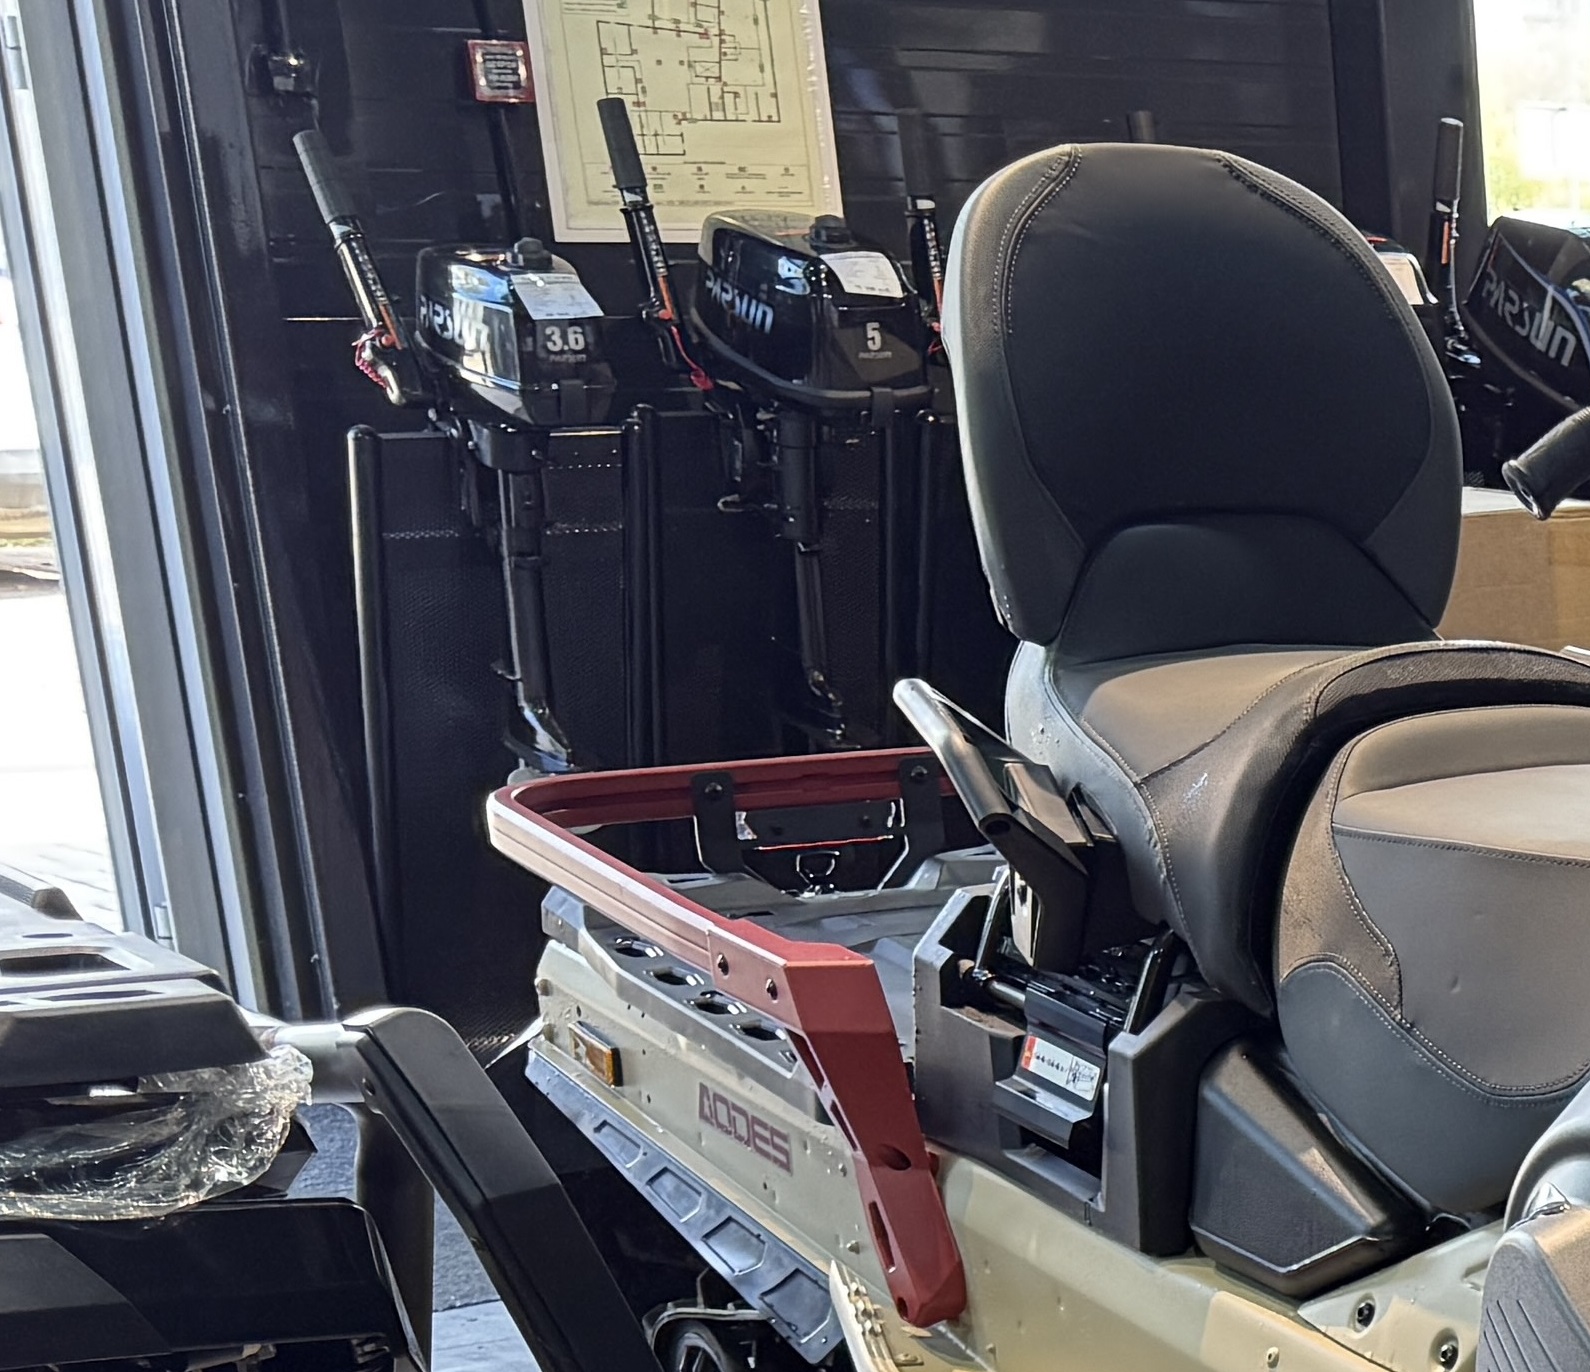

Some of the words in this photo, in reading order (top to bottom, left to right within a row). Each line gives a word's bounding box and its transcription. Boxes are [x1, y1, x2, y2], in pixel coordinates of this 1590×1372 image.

[545, 326, 585, 351] 3.6
[866, 322, 882, 350] 5
[698, 1082, 793, 1176] AODES
